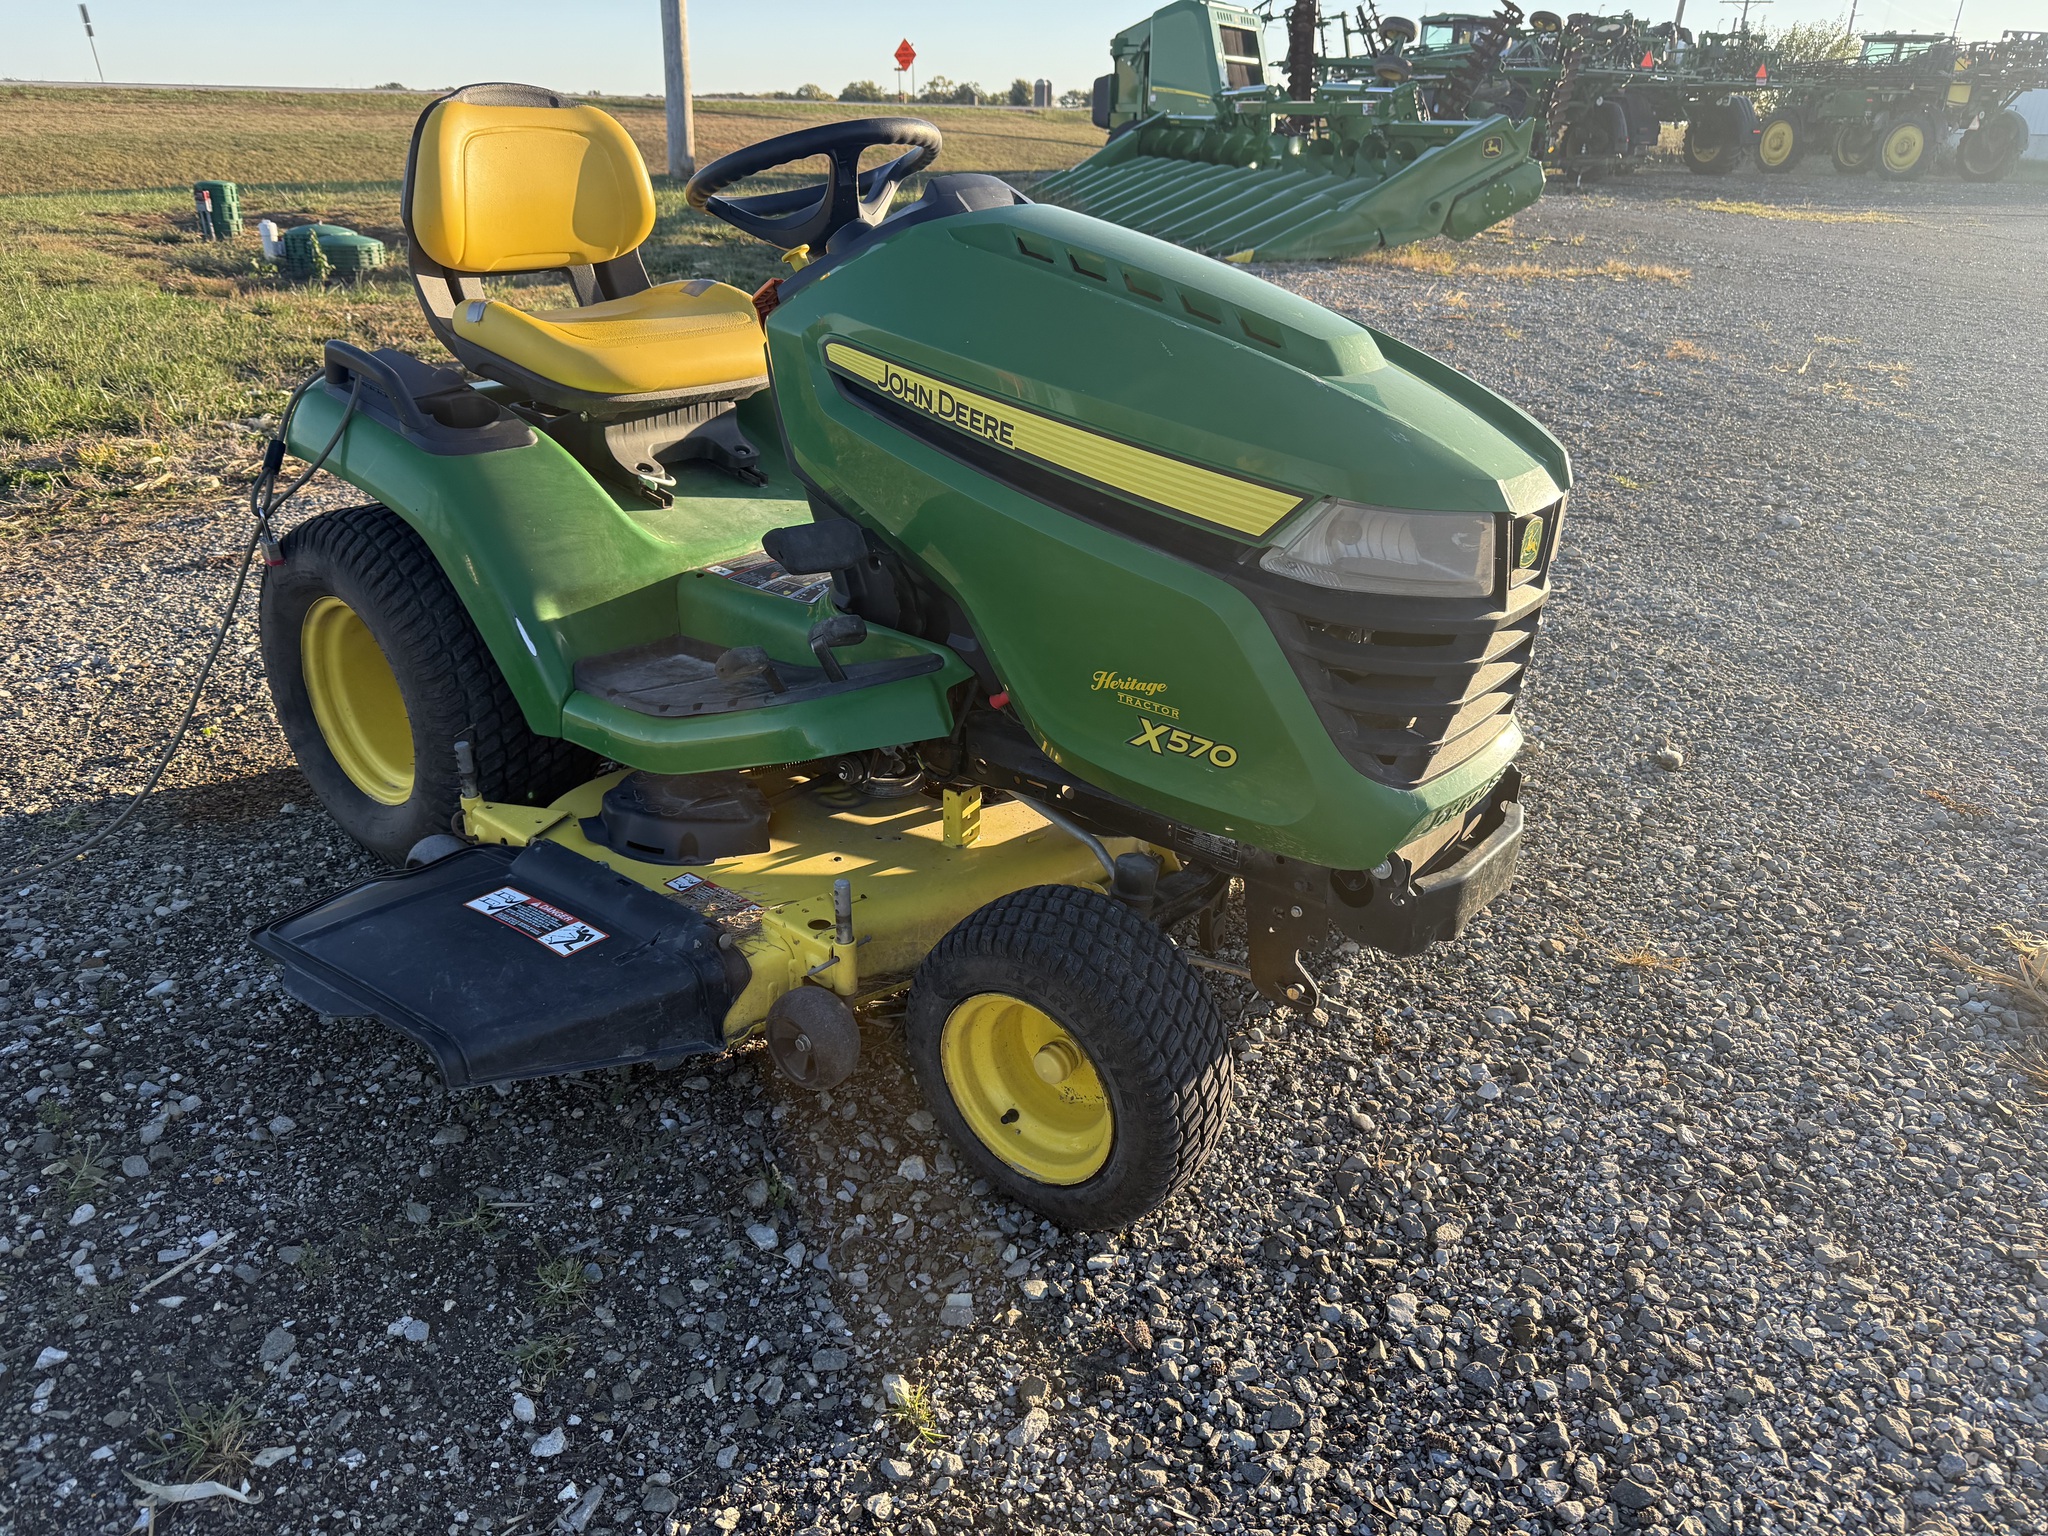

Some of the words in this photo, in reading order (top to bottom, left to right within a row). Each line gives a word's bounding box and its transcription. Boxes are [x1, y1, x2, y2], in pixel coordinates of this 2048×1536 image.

[877, 364, 933, 411] JOHN
[938, 388, 1015, 447] DEERE
[1091, 671, 1168, 696] Heritage
[1117, 693, 1180, 718] TRACTOR
[1128, 716, 1238, 768] X570
[540, 904, 574, 922] DANGER
